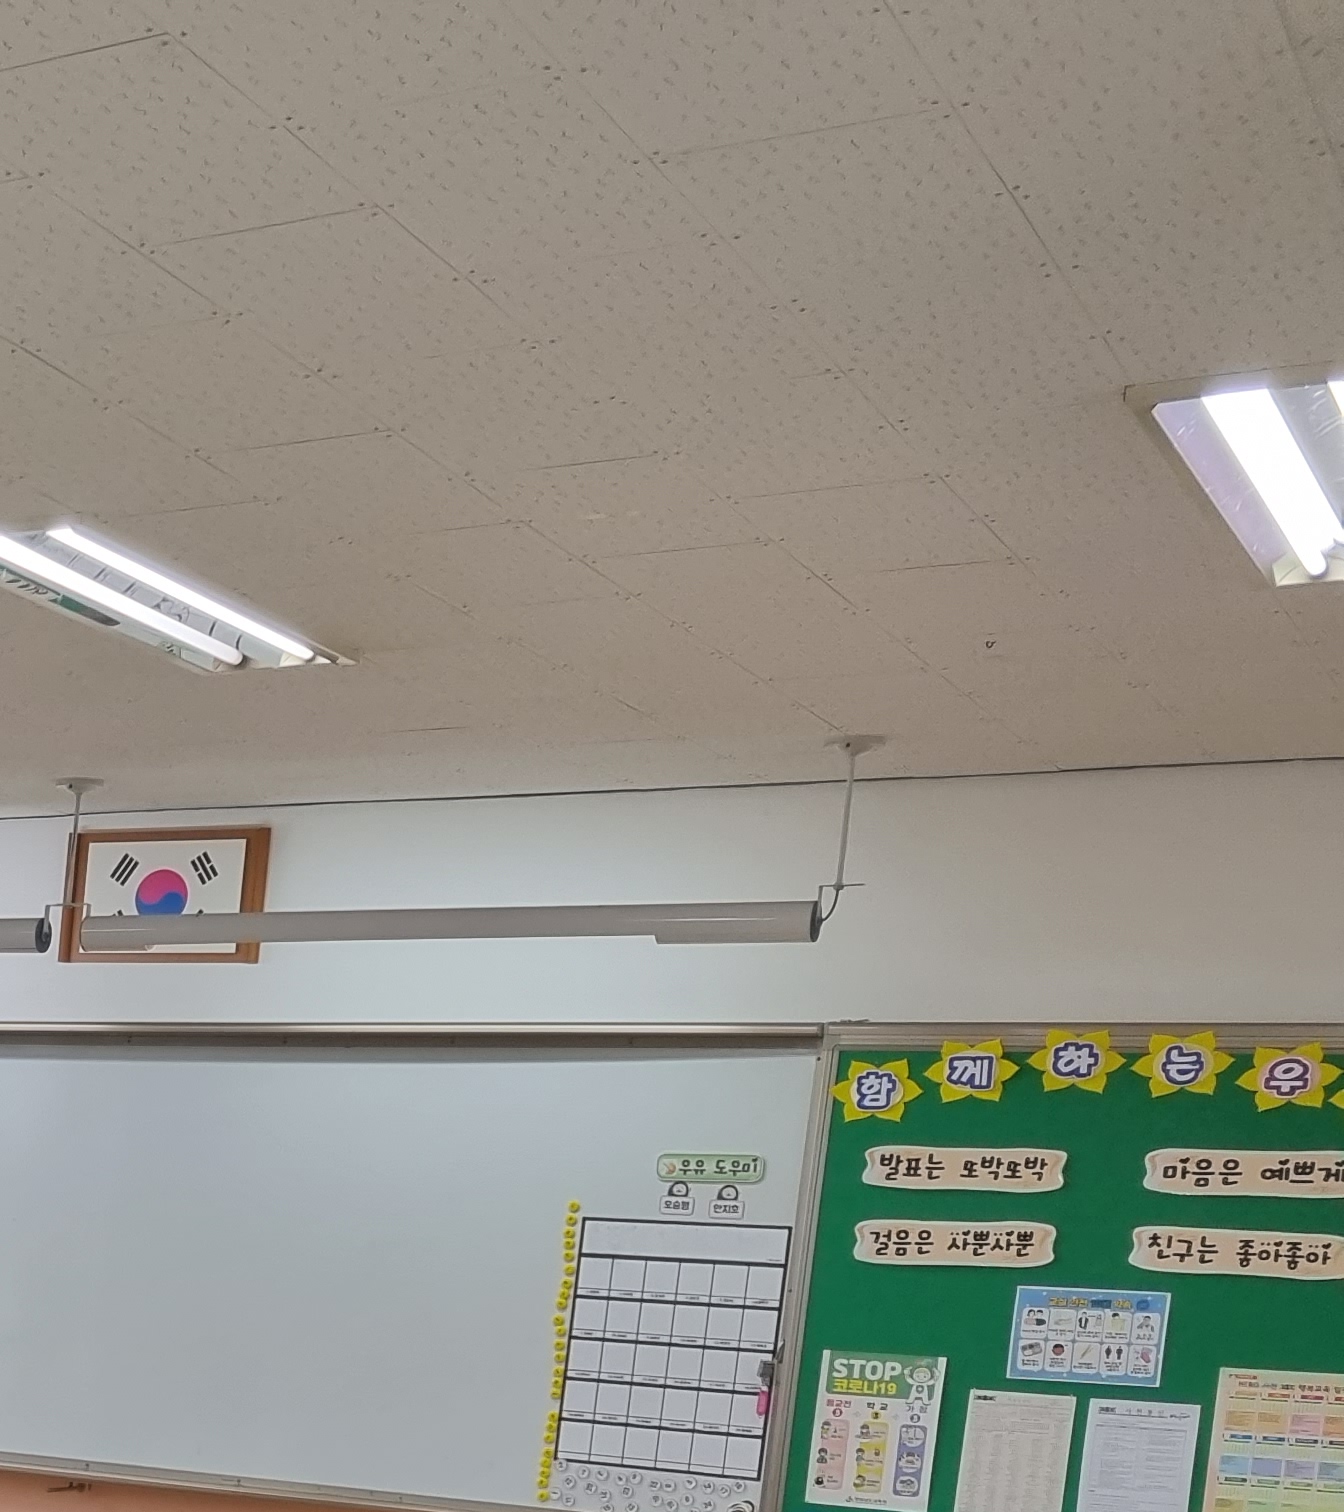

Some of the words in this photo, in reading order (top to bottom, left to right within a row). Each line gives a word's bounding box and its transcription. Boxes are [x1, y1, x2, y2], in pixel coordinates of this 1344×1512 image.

[678, 1159, 707, 1175] 우유
[713, 1157, 759, 1177] 도우미
[879, 1153, 945, 1180] 발표는
[960, 1156, 1049, 1182] 또박또박
[1162, 1157, 1243, 1187] 마음은
[1260, 1158, 1344, 1184] 예쁘게
[869, 1229, 934, 1257] 걸음은
[947, 1229, 1035, 1257] 사뿐사뿐
[1148, 1233, 1219, 1264] 친구는
[1236, 1239, 1332, 1270] 좋아좋아
[832, 1358, 902, 1381] STOP
[832, 1378, 898, 1395] 코로나19
